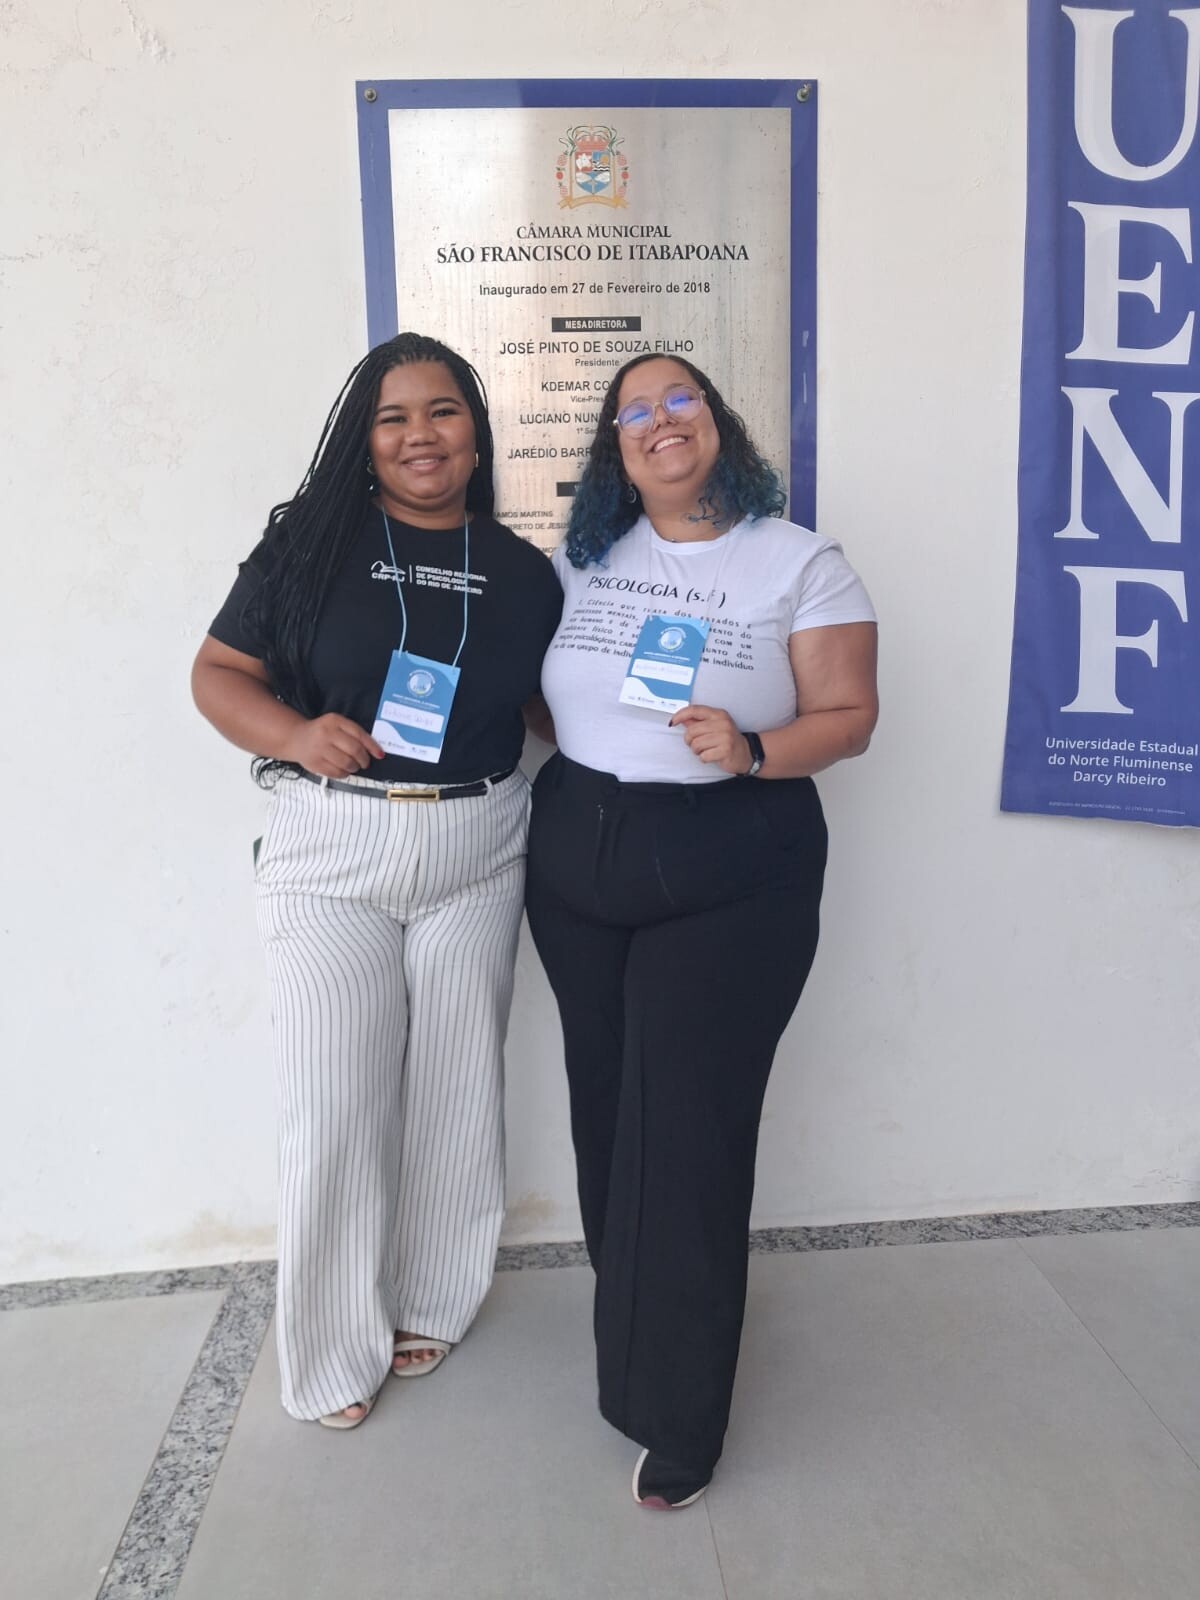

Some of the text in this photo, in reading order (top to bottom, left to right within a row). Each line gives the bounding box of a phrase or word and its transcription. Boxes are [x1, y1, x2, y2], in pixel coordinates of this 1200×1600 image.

[516, 222, 672, 239] CÂMARA MUNICIPAL
[437, 243, 749, 264] SÃO FRANCISCO DE ITABAPOANA
[479, 282, 710, 298] Inaugurado em 27 de Fevereiro de 2018
[500, 338, 694, 354] JOSÉ PINTO DE SOUZA FILHO
[575, 358, 620, 367] Presidente
[1053, 5, 1200, 715] UENF
[520, 413, 571, 424] LUCIANO
[507, 445, 557, 459] JARÉDIO
[415, 565, 453, 576] CONSELHO
[441, 582, 451, 590] DE
[587, 575, 678, 598] PSICOLOGIA
[1045, 737, 1199, 756] Universidade Estadual
[1048, 753, 1193, 773] do Norte Fluminense
[1073, 770, 1167, 786] Darcy Ribeiro
